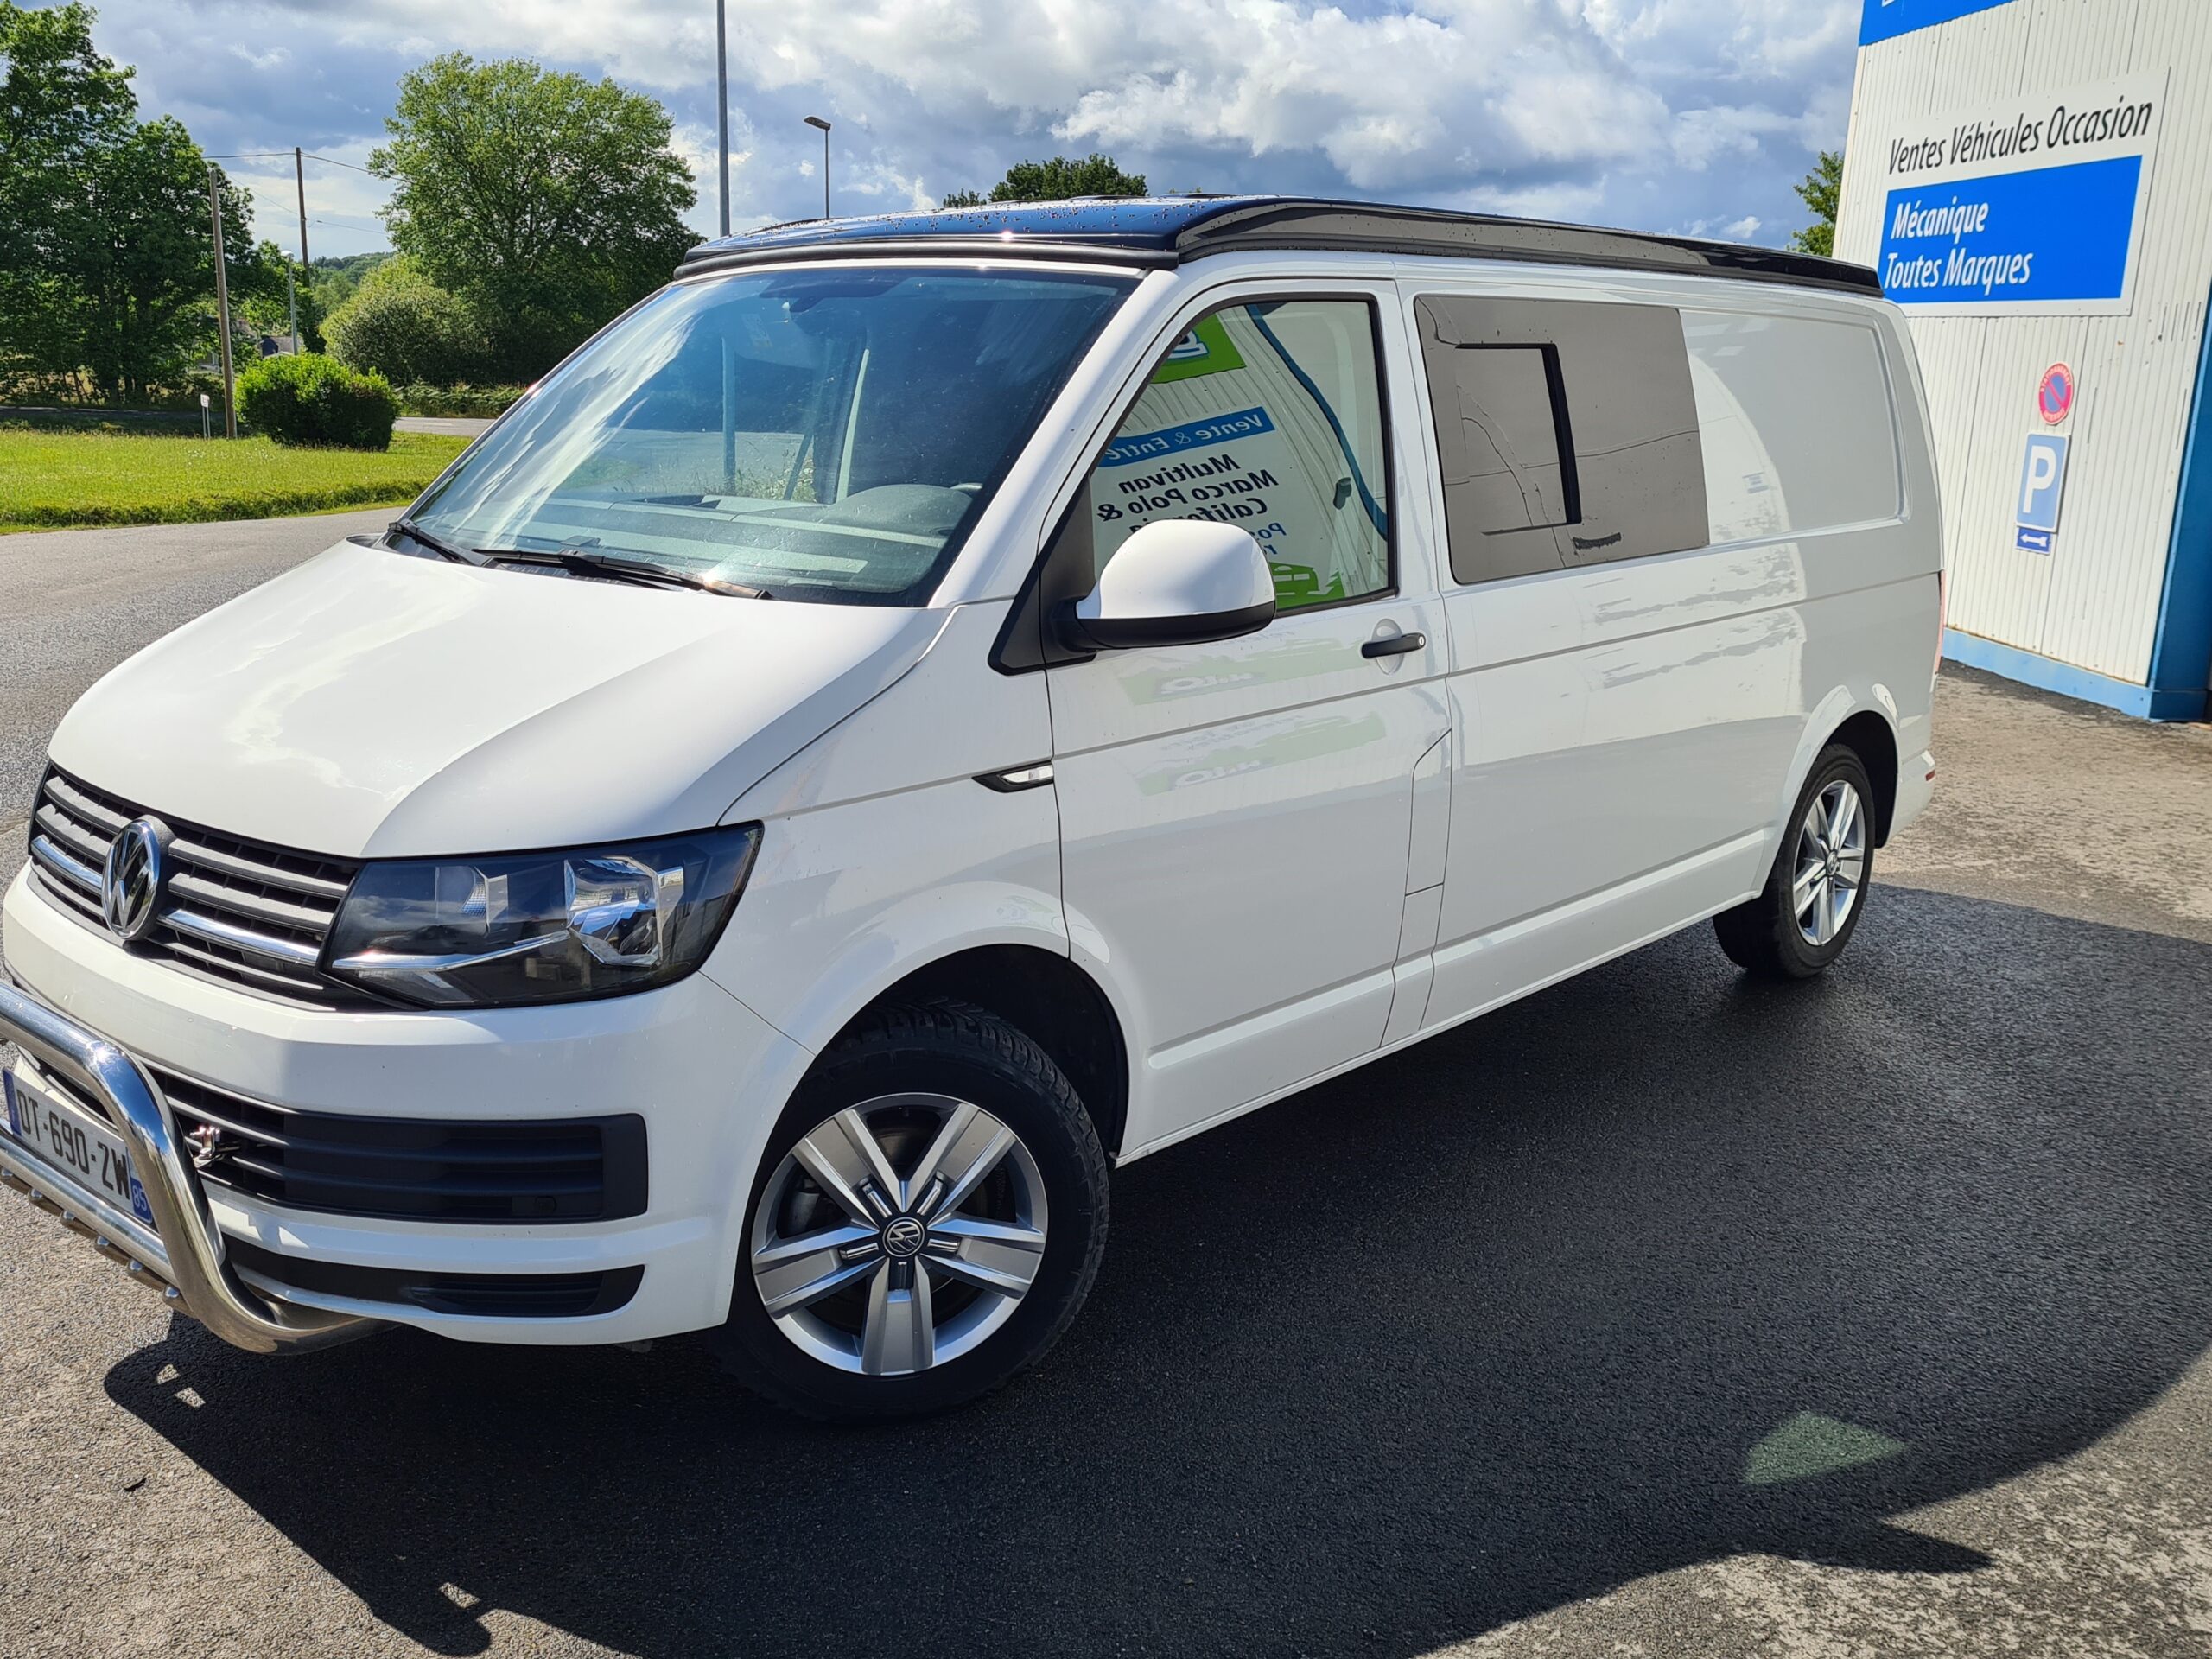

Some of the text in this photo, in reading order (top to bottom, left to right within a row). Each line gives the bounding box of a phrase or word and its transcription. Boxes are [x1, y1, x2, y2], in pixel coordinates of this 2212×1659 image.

[1888, 95, 2153, 175] Ventes Véhicules Occasion
[1890, 196, 1990, 244] Mécanique
[1884, 248, 2033, 296] Toutes Marques
[2022, 445, 2057, 513] P
[16, 1089, 130, 1200] DT-690-ZW
